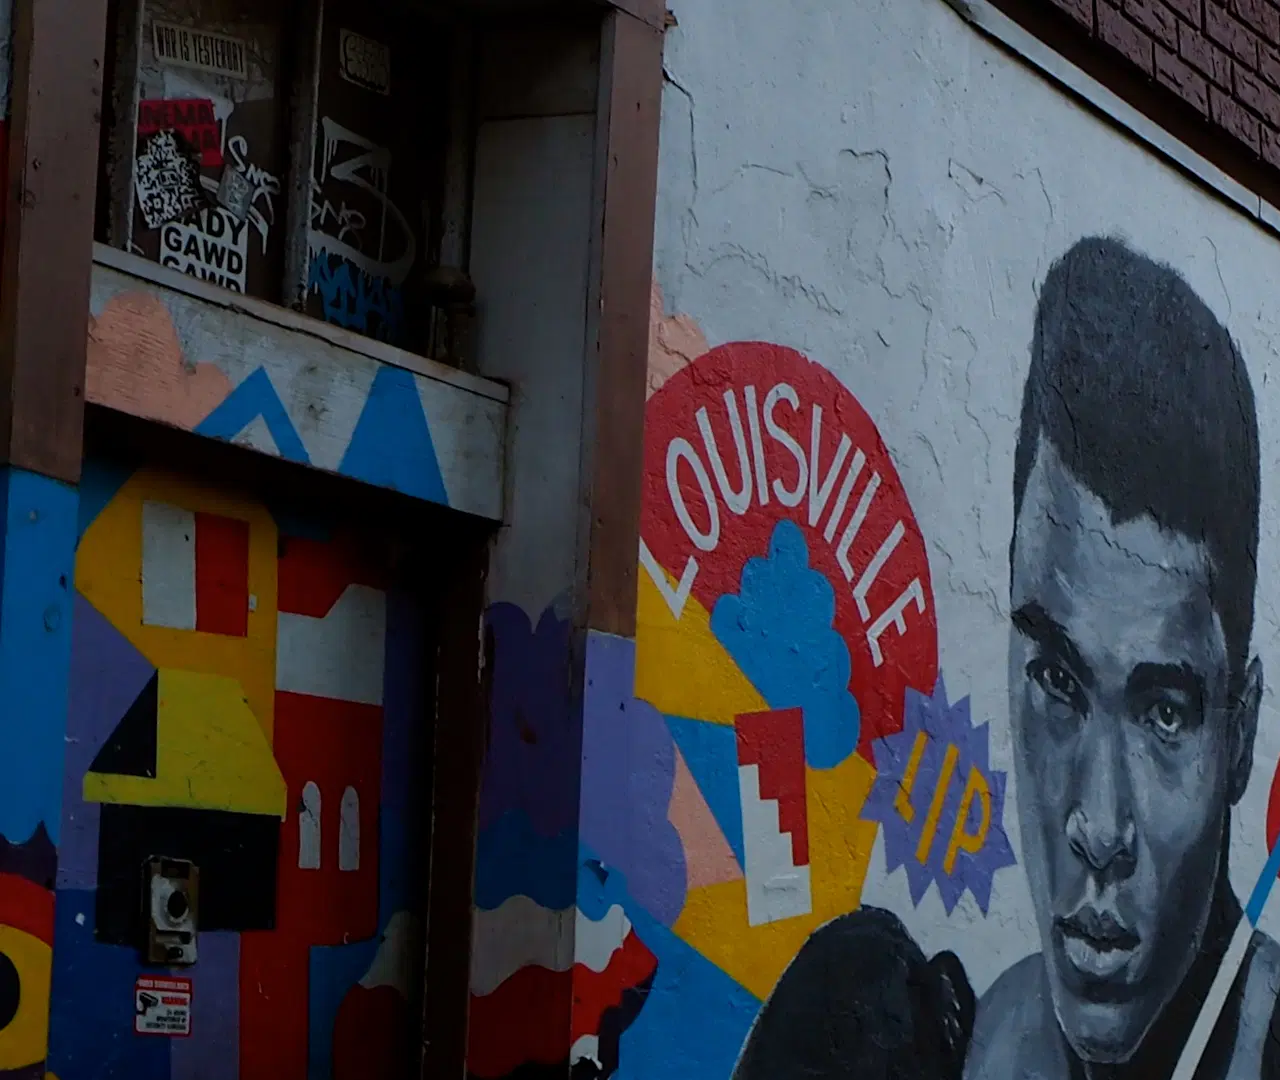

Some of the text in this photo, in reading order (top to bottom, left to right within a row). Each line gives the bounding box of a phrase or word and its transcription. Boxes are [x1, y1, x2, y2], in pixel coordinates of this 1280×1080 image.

[180, 31, 190, 62] IS
[163, 226, 244, 275] GAWD
[639, 381, 926, 668] LOUISVILLE
[895, 731, 990, 874] LIP
